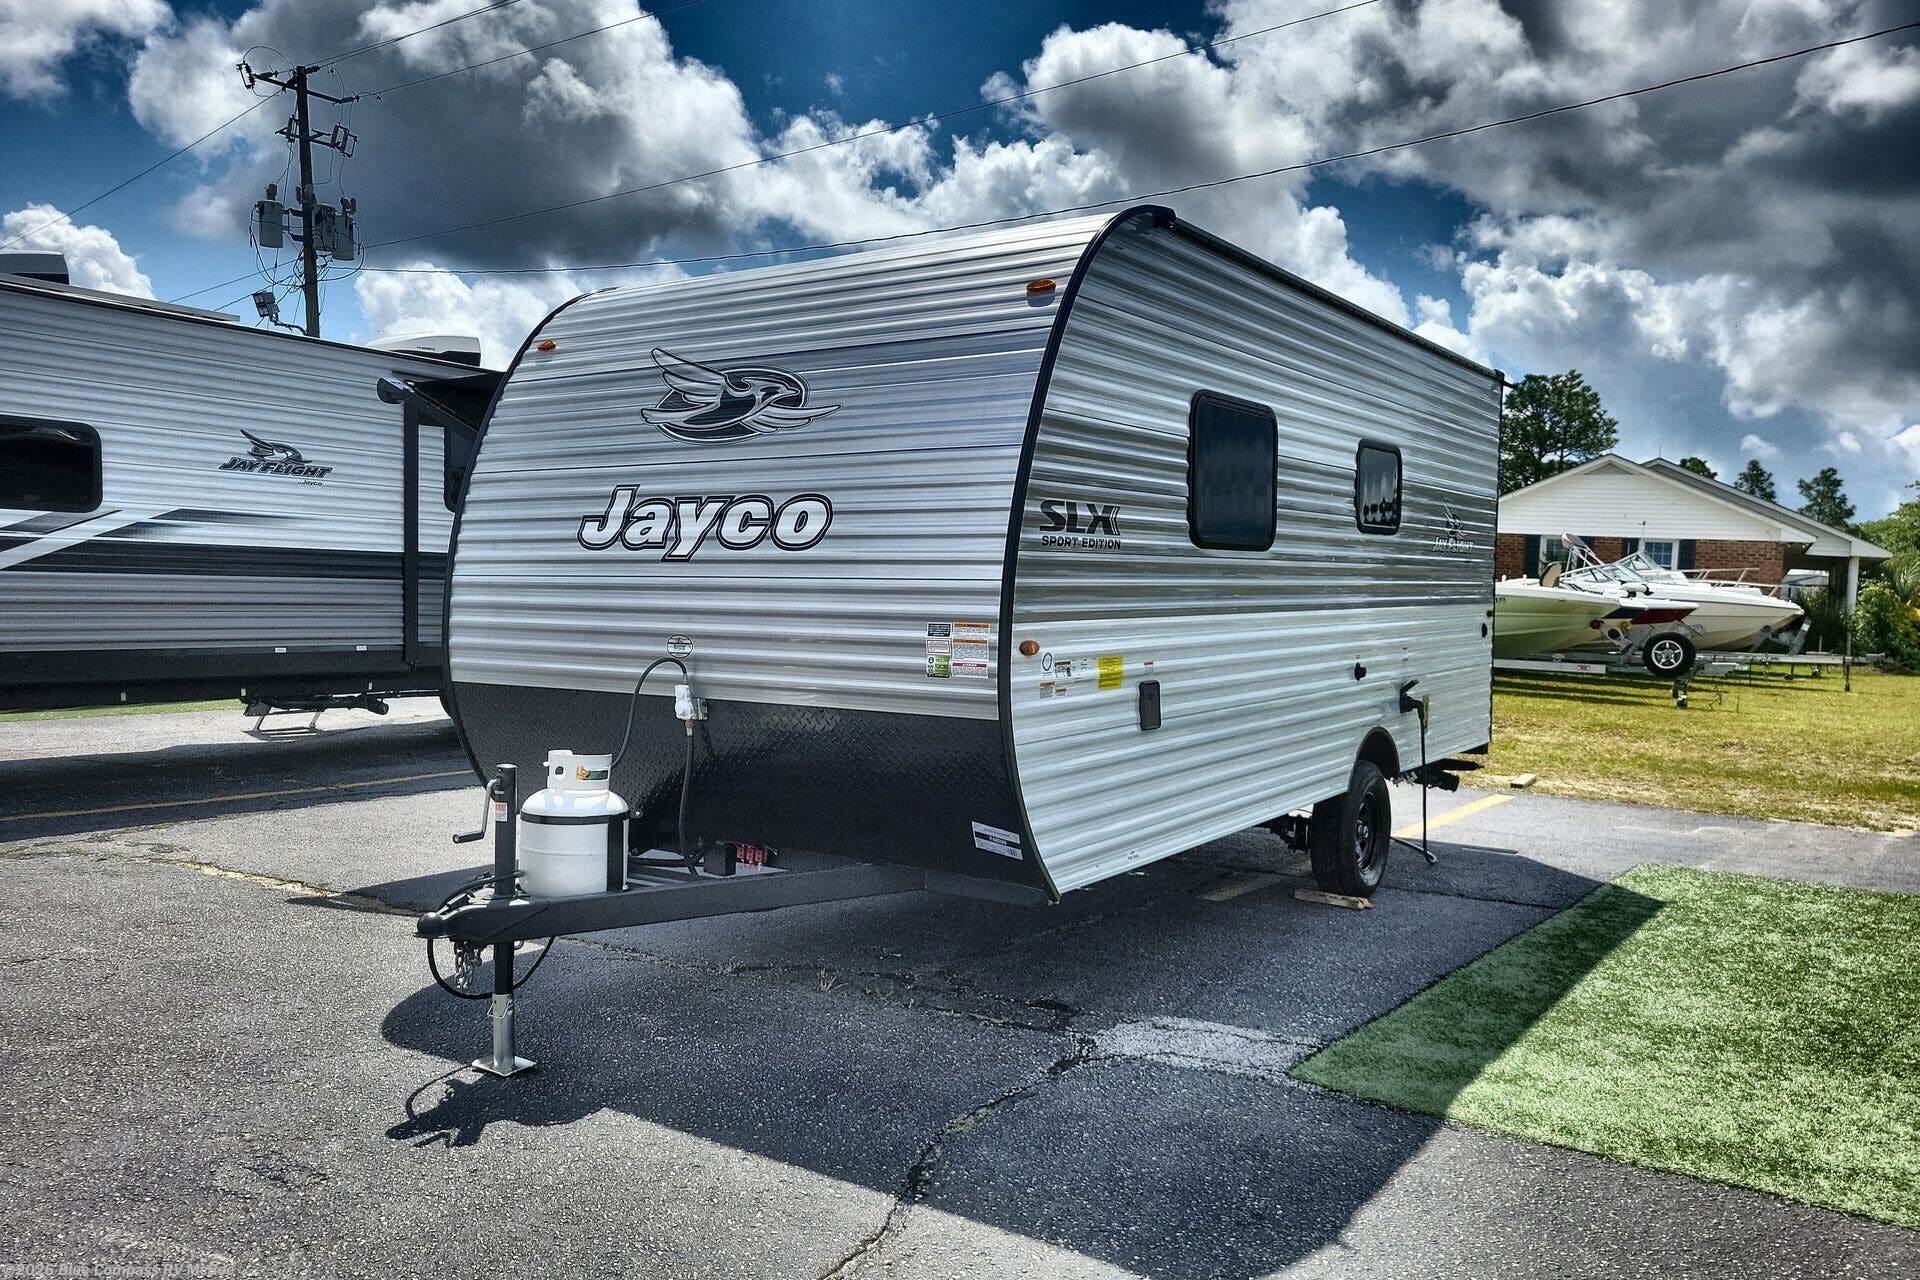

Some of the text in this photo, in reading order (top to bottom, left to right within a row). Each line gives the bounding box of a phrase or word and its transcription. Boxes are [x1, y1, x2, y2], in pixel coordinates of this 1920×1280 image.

[218, 456, 333, 479] JAY FLIGHT
[577, 484, 834, 562] Jayco
[1040, 499, 1121, 536] SLX
[1041, 535, 1121, 550] SPORT EDITION
